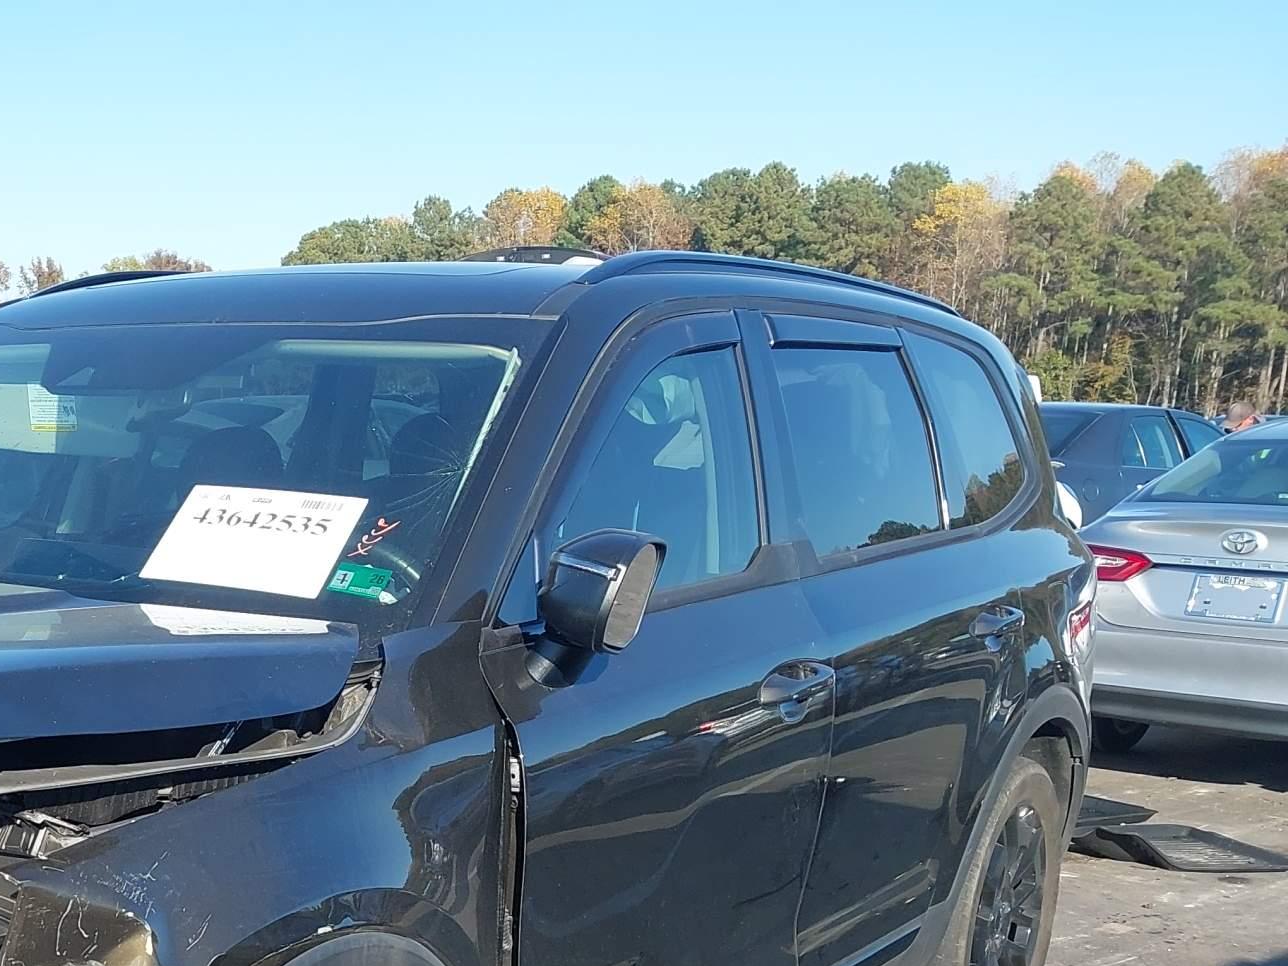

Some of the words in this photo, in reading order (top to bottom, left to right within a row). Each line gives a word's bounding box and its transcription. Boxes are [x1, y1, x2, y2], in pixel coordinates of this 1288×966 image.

[193, 508, 332, 535] 43642535
[1179, 557, 1288, 569] CAMR
[369, 573, 386, 585] 26
[1217, 576, 1246, 585] LEITH
